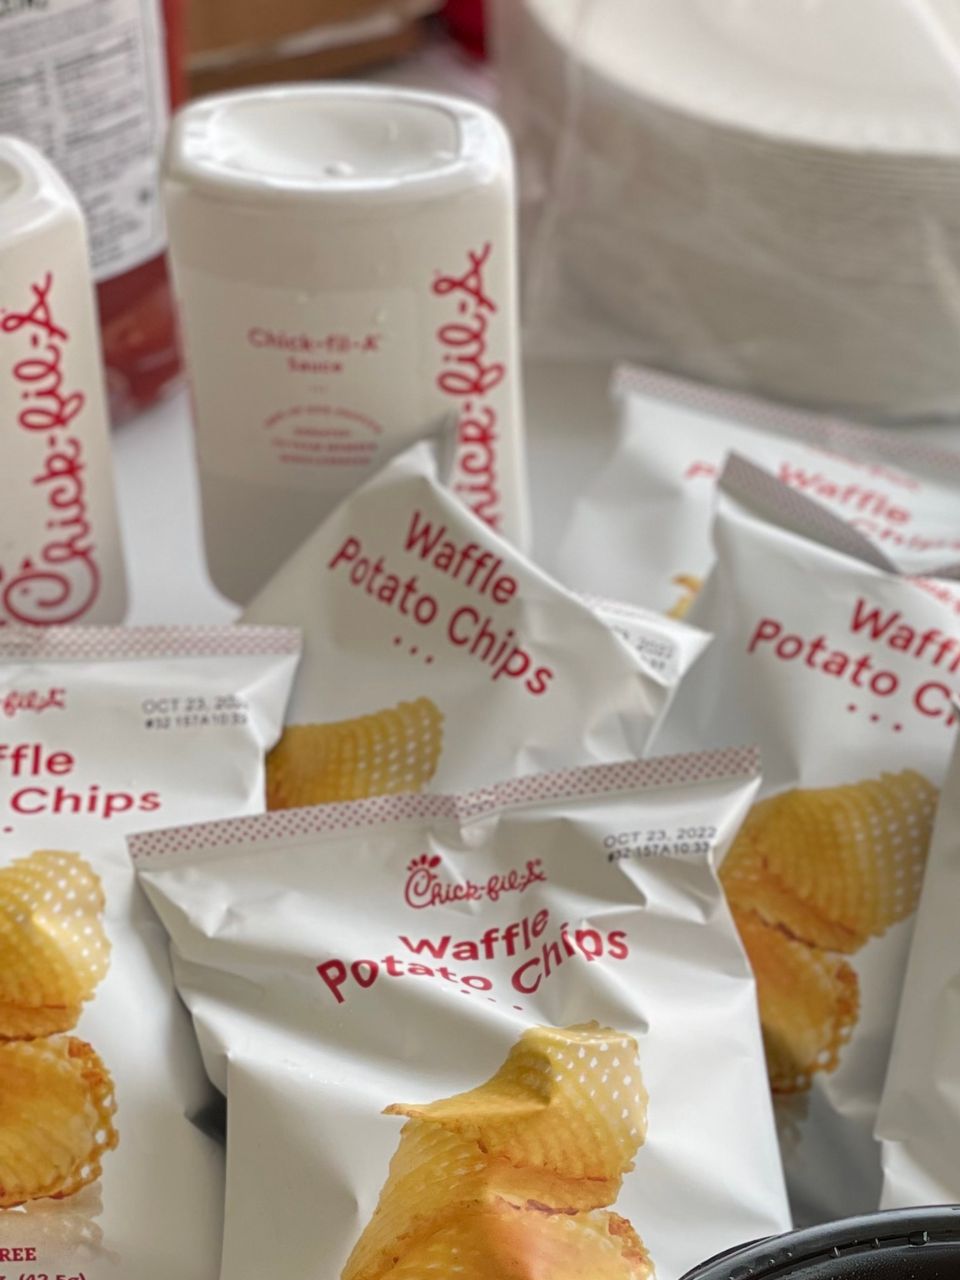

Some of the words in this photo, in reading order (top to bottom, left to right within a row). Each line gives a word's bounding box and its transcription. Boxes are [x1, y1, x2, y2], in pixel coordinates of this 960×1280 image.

[404, 511, 519, 604] Waffle
[328, 536, 440, 626] Potato
[447, 605, 554, 695] Chips
[747, 617, 900, 697] Potato
[10, 785, 162, 819] Chips
[603, 830, 642, 849] OCT
[676, 825, 718, 841] 2022
[316, 953, 493, 1005] Potato
[511, 922, 630, 996] Chips
[398, 908, 550, 962] Waffle
